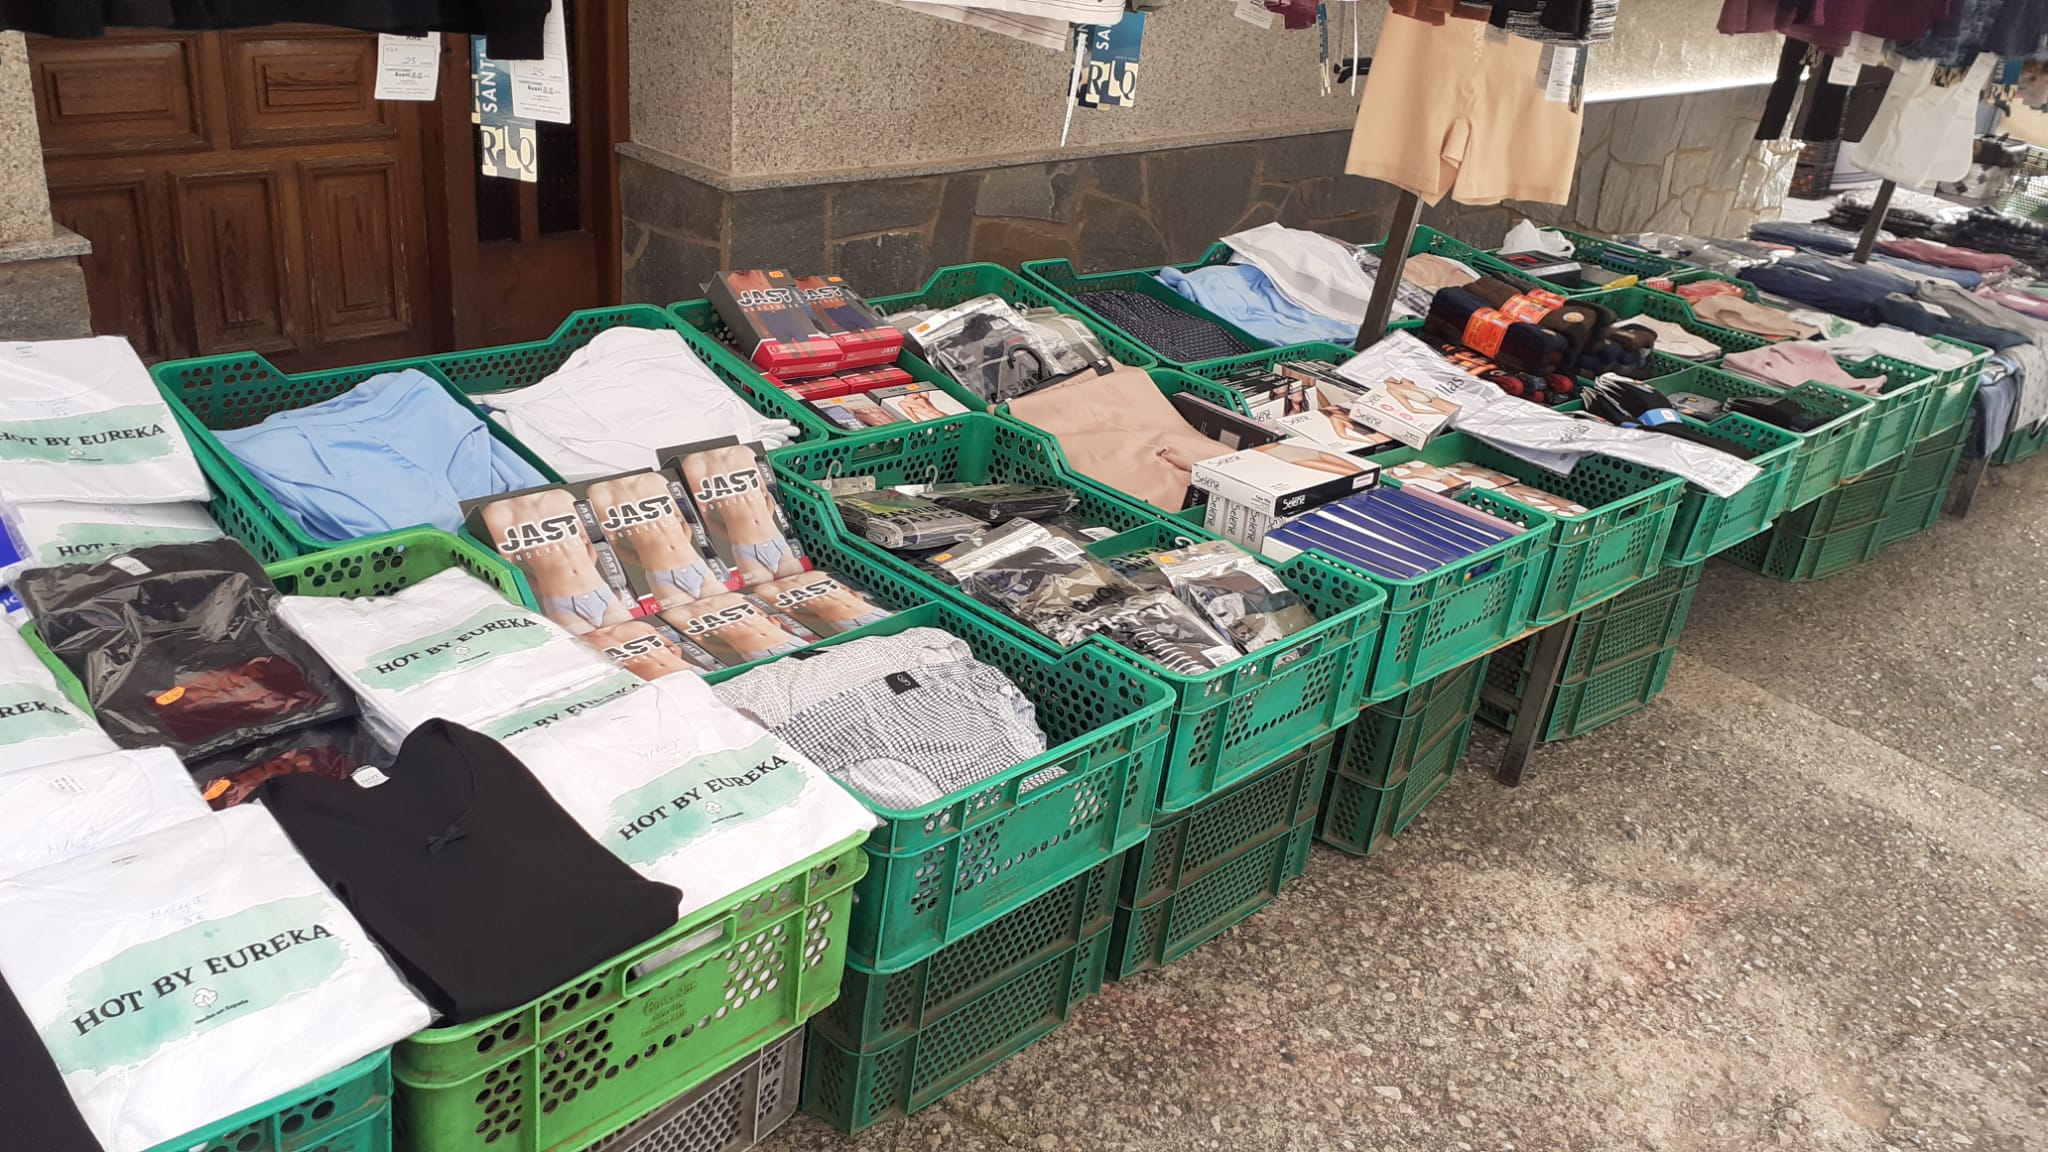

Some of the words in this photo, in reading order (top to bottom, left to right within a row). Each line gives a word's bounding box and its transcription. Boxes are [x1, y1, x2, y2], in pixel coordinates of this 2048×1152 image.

[737, 287, 793, 307] JAST
[1434, 375, 1465, 397] llas
[41, 436, 73, 447] BY
[79, 423, 167, 447] EUREKA
[695, 467, 761, 502] JAST
[579, 503, 595, 525] JAST
[602, 495, 674, 531] JAST
[1206, 494, 1220, 527] Selene
[1227, 502, 1240, 536] Selene
[1247, 510, 1260, 543] Selene
[499, 513, 581, 553] JAST
[603, 550, 618, 575] JAST
[775, 578, 840, 608] JAST
[684, 602, 757, 635] JAST
[374, 651, 422, 675] HOT
[426, 641, 452, 656] BY
[455, 617, 539, 643] EUREKA
[602, 634, 665, 660] AST
[0, 700, 70, 718] REKA
[617, 805, 670, 841] HOT
[670, 786, 703, 811] BY
[703, 754, 789, 794] EUREKA
[70, 989, 145, 1036] HOT
[150, 966, 196, 998] BY
[203, 923, 335, 976] EUREKA
